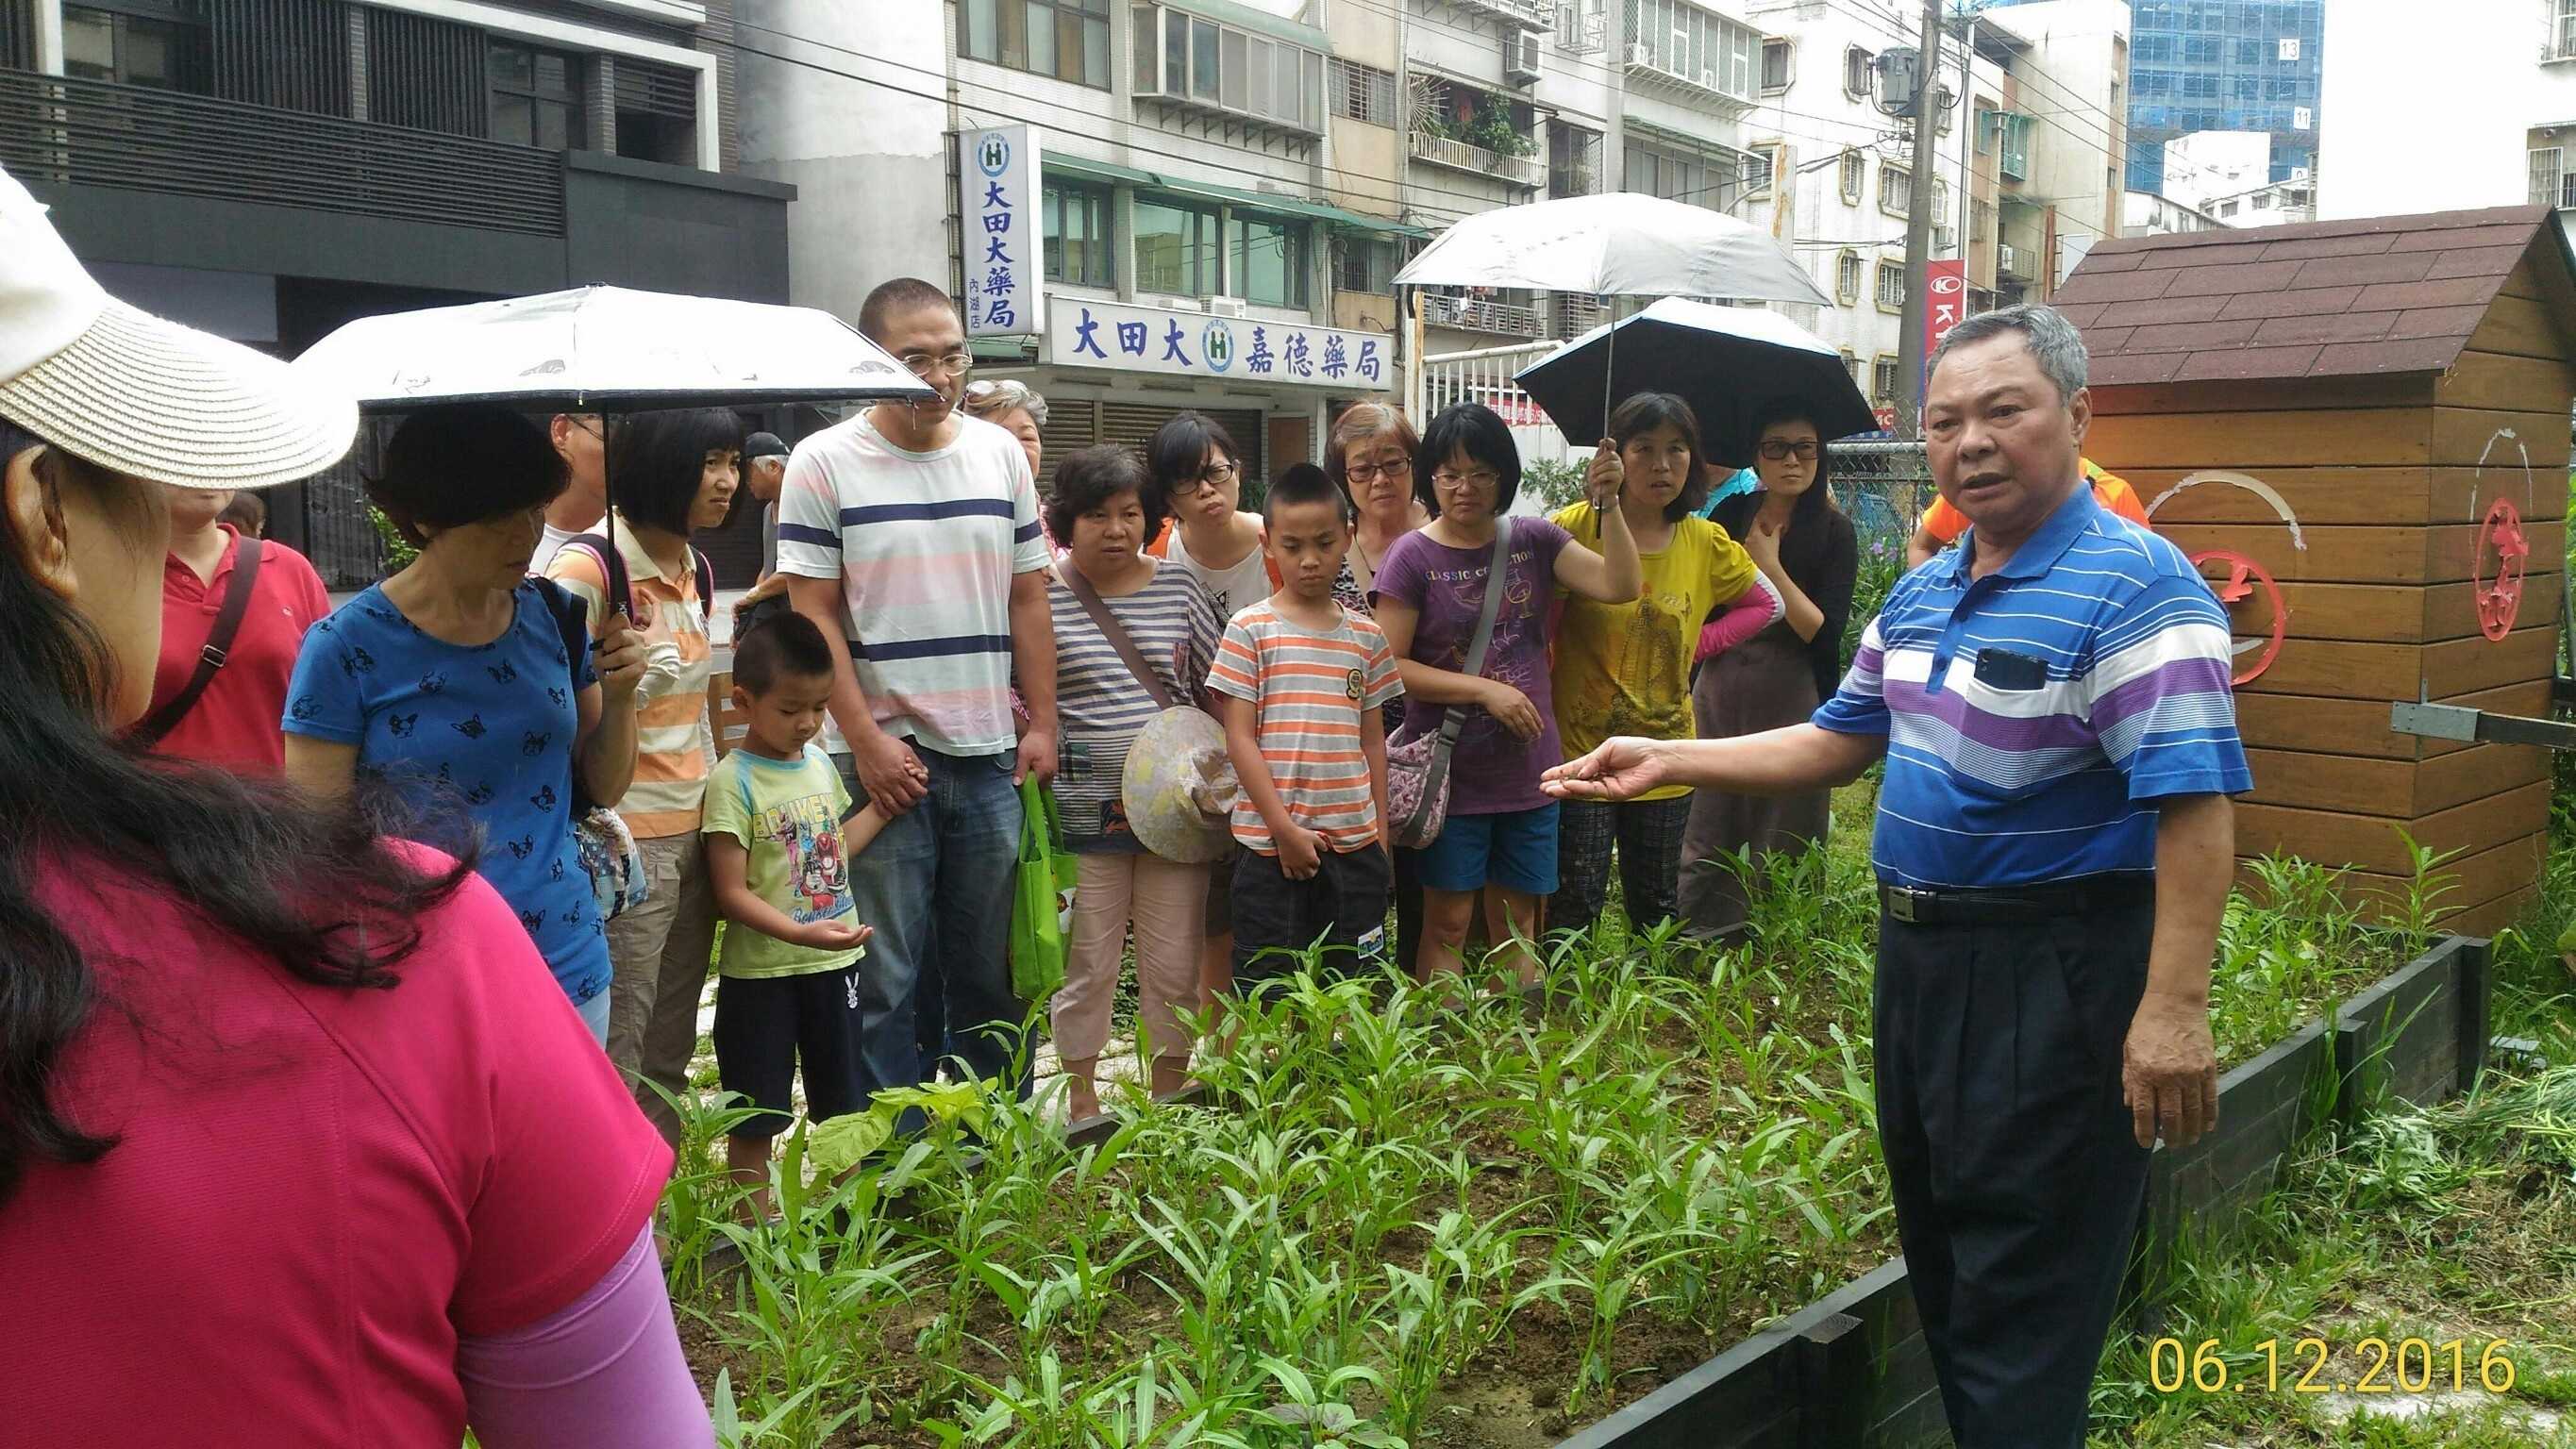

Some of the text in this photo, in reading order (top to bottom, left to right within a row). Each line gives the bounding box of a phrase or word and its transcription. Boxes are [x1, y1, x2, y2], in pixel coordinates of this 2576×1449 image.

[2281, 42, 2298, 58] 13
[2297, 110, 2309, 126] 11
[982, 180, 1015, 328] 大田大藥局
[1073, 308, 1194, 367] 大田大
[1245, 326, 1381, 383] 嘉德藥局
[1425, 551, 1535, 581] CLASSIC CTION
